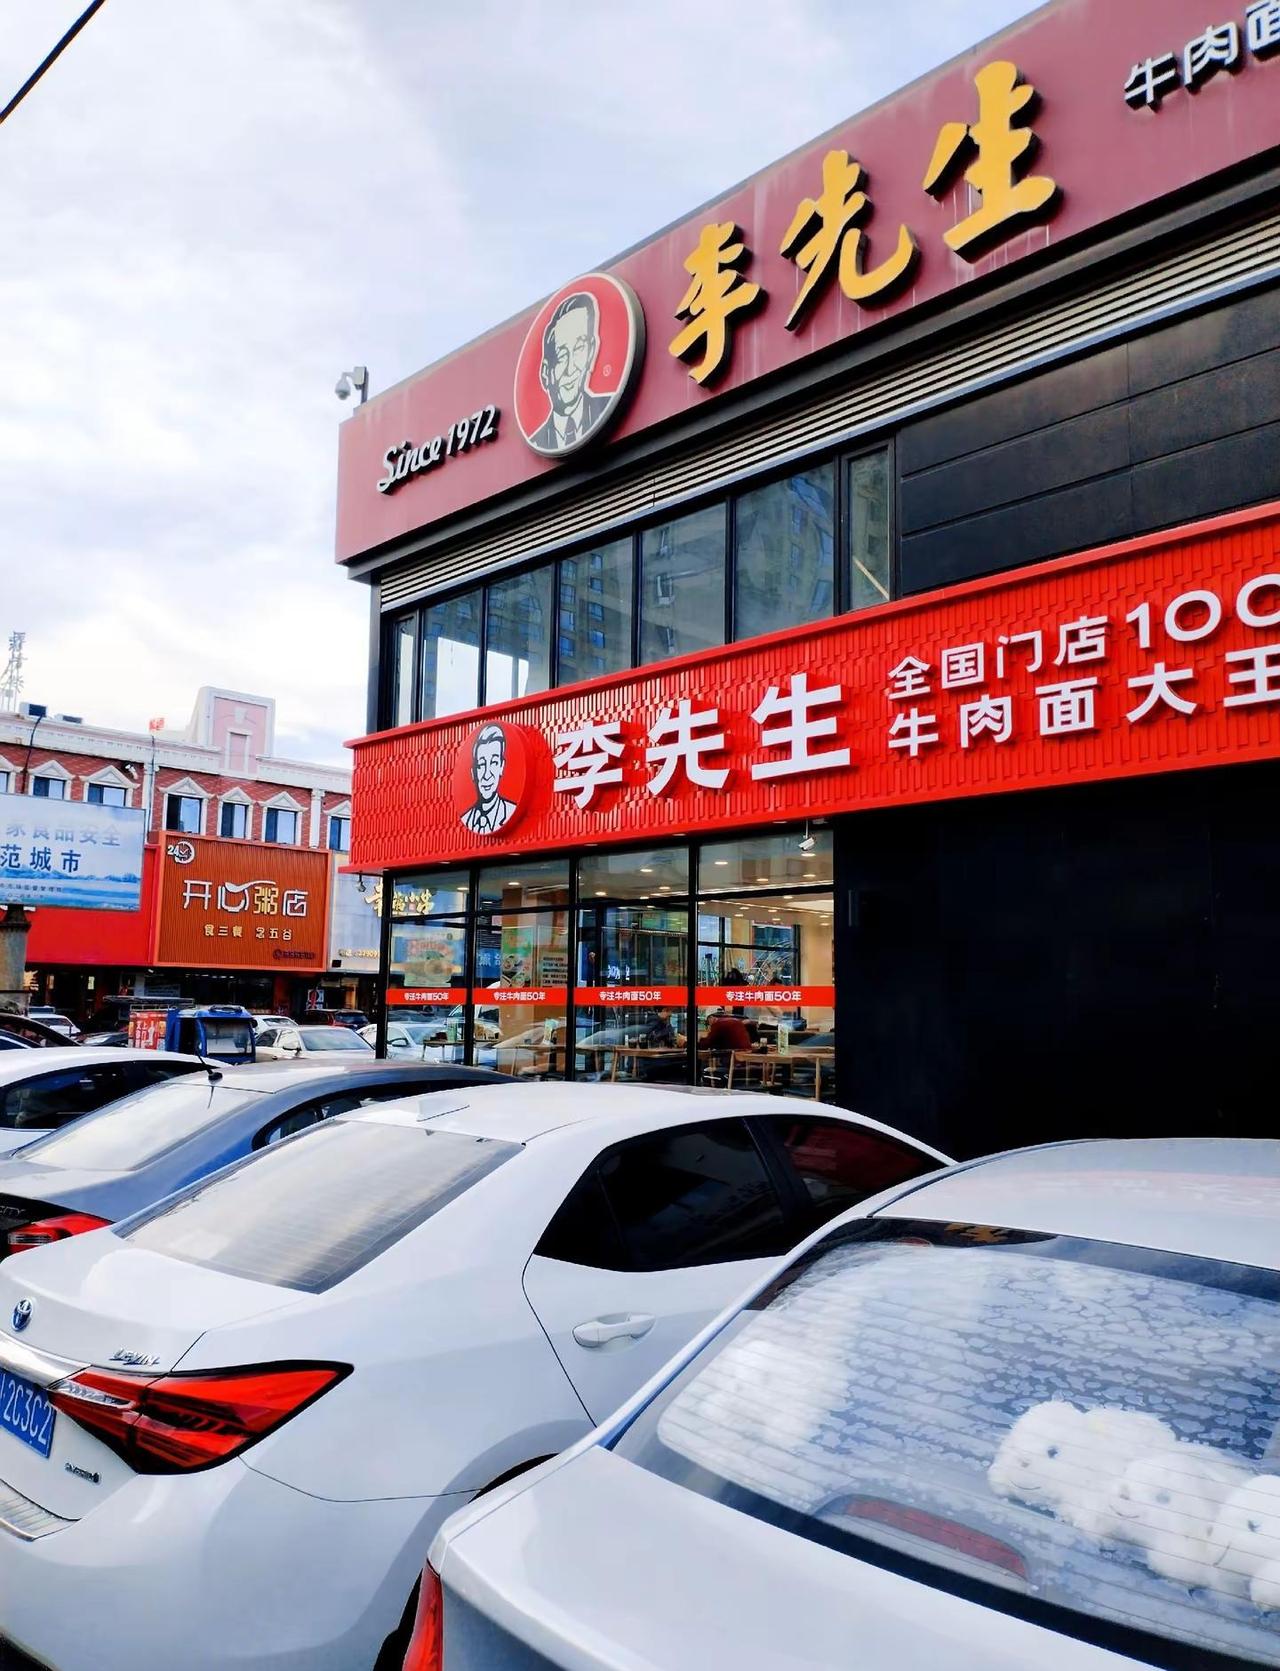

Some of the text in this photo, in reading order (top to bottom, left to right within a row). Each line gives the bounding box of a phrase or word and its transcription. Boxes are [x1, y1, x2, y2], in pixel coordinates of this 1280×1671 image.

[669, 61, 1057, 385] 李先生
[377, 404, 501, 493] Since 1972
[888, 643, 1280, 758] 牛肉面大王
[552, 673, 850, 809] 李先生
[0, 844, 82, 873] 范城市
[183, 880, 309, 917] 开心粥店
[599, 991, 662, 1001] 专注牛肉面50年
[726, 991, 802, 1001] 专注牛肉面50年
[0, 1373, 52, 1446] 2C3C2
